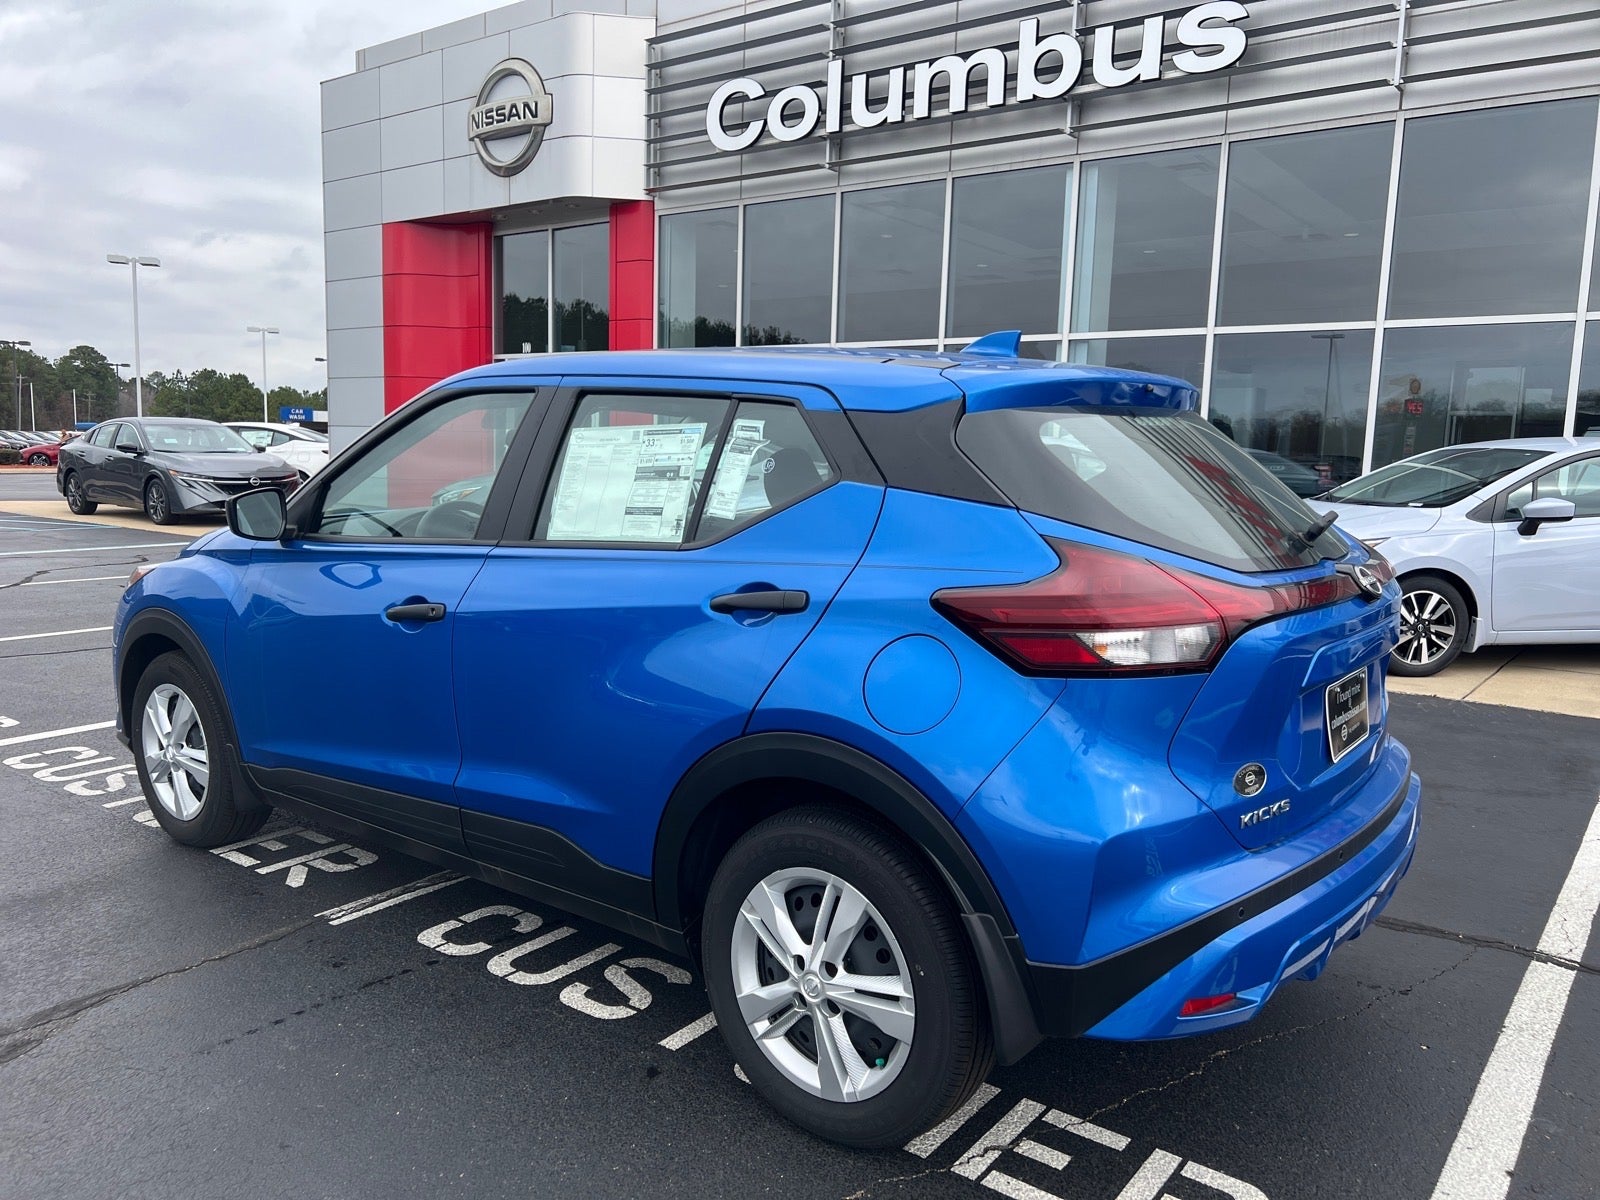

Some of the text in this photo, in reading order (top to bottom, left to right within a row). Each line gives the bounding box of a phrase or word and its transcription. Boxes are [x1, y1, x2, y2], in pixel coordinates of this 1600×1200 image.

[706, 0, 1250, 152] Columbus
[471, 100, 538, 131] NISSAN
[522, 342, 531, 353] 100
[645, 438, 655, 447] 33
[1240, 798, 1291, 829] KICKS
